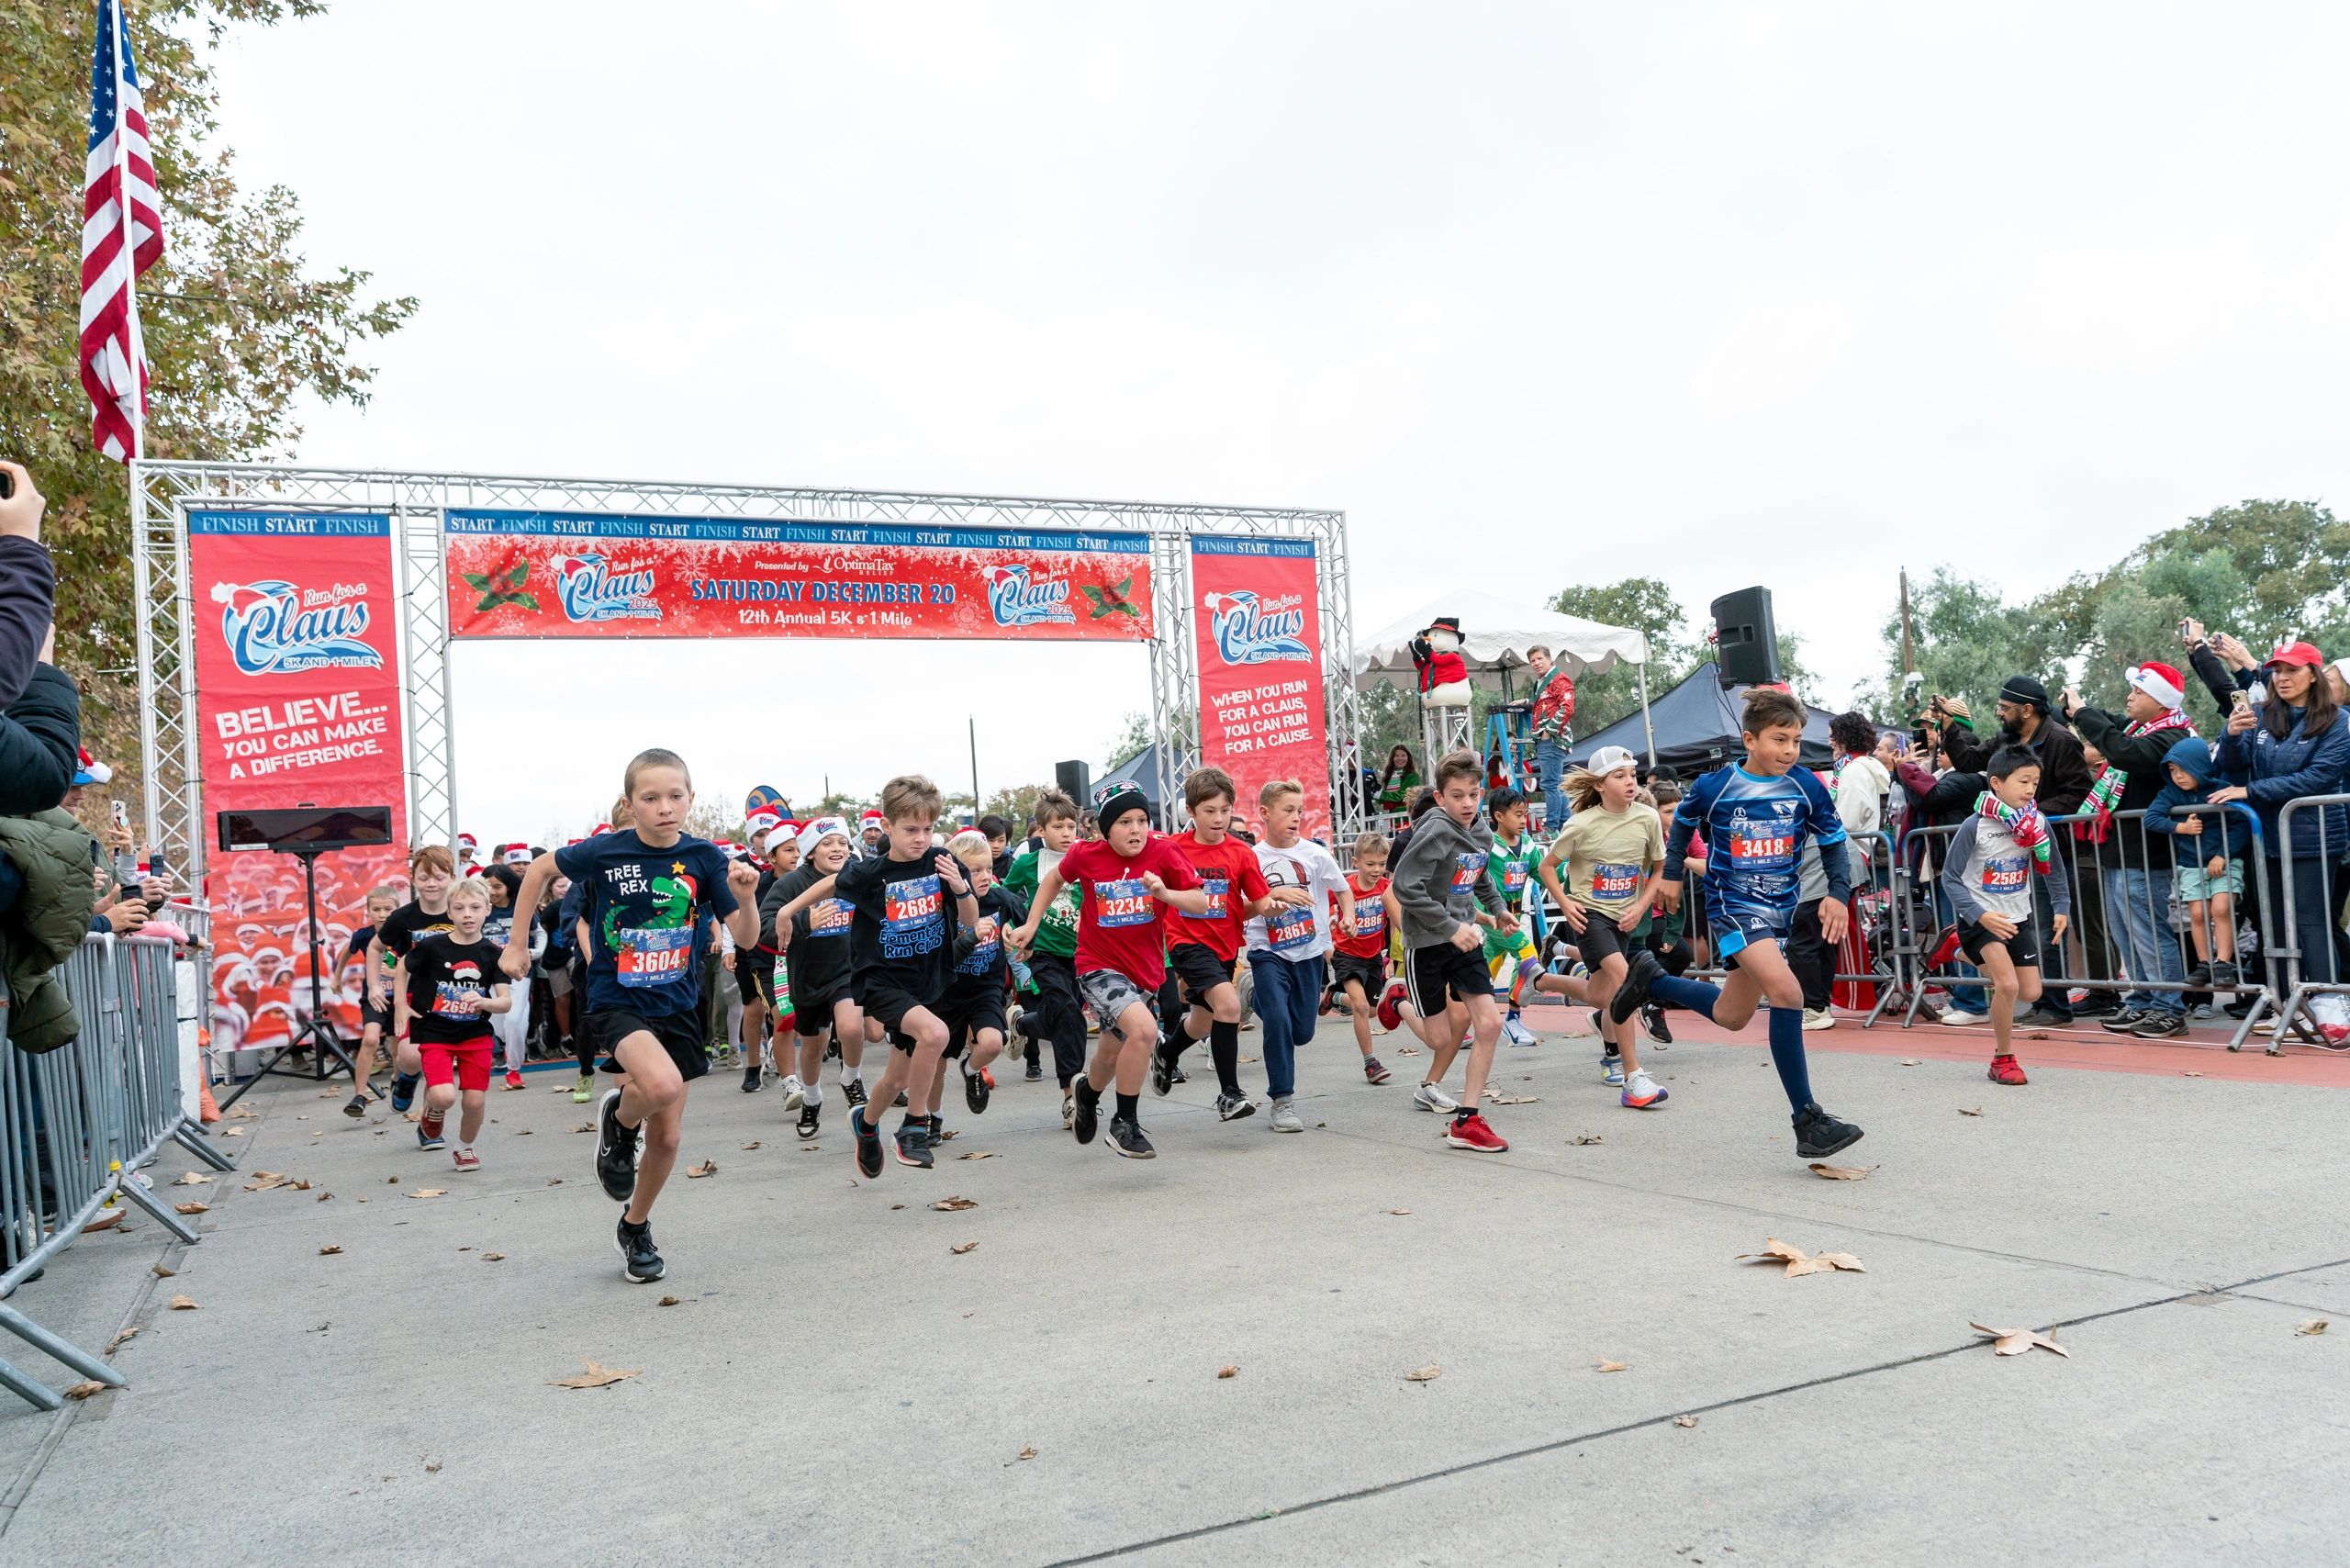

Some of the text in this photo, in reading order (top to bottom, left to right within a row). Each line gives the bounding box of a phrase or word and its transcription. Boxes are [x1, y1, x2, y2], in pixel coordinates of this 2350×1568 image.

[202, 517, 379, 533] FINISH START FINISH
[451, 518, 1147, 551] START FINISH START FINISH START FINISH START FINISH START FINISH START FINISH START FINISH START FINISH
[1199, 541, 1309, 555] FINISH START FINISH
[611, 561, 629, 572] Run
[631, 556, 643, 571] for
[755, 561, 798, 570] Presented
[799, 562, 809, 572] by
[1034, 571, 1048, 581] Run
[1049, 568, 1061, 581] for
[305, 584, 366, 606] Run for a
[565, 564, 655, 621] Claus
[691, 578, 956, 604] SATURDAY DECEMBER 20
[994, 575, 1069, 624] Claus
[629, 599, 657, 609] 2025
[1047, 605, 1071, 614] 2025
[1263, 594, 1302, 611] Run for a
[738, 609, 769, 624] 12th
[774, 610, 826, 625] Annual
[830, 611, 852, 624] 5K
[870, 612, 877, 624] 1
[881, 611, 912, 626] Mile
[236, 597, 368, 671] Claus
[1221, 603, 1303, 663] Claus
[285, 657, 300, 667] 5K
[303, 657, 329, 667] AND
[342, 657, 370, 666] MILE
[1251, 652, 1262, 660] 5K
[1263, 652, 1279, 660] AND
[1211, 680, 1308, 708] WHEN YOU RUN
[216, 691, 388, 739] BELIEVE...
[1218, 698, 1307, 723] FOR A CLAUS,
[1224, 712, 1308, 739] YOU CAN RUN
[224, 717, 387, 759] YOU CAN MAKE
[1225, 728, 1313, 755] FOR A CAUSE.
[229, 739, 383, 779] A DIFFERENCE.
[1741, 838, 1784, 857] 3418
[605, 865, 642, 883] TREE
[1991, 870, 2022, 885] 2583
[620, 879, 648, 897] REX
[1601, 878, 1632, 890] 3655
[896, 895, 936, 920] 2683
[1105, 897, 1145, 916] 3234
[1276, 922, 1307, 942] 2861
[885, 936, 942, 958] Run Club
[632, 948, 680, 973] 3604
[441, 1000, 476, 1014] 2694
